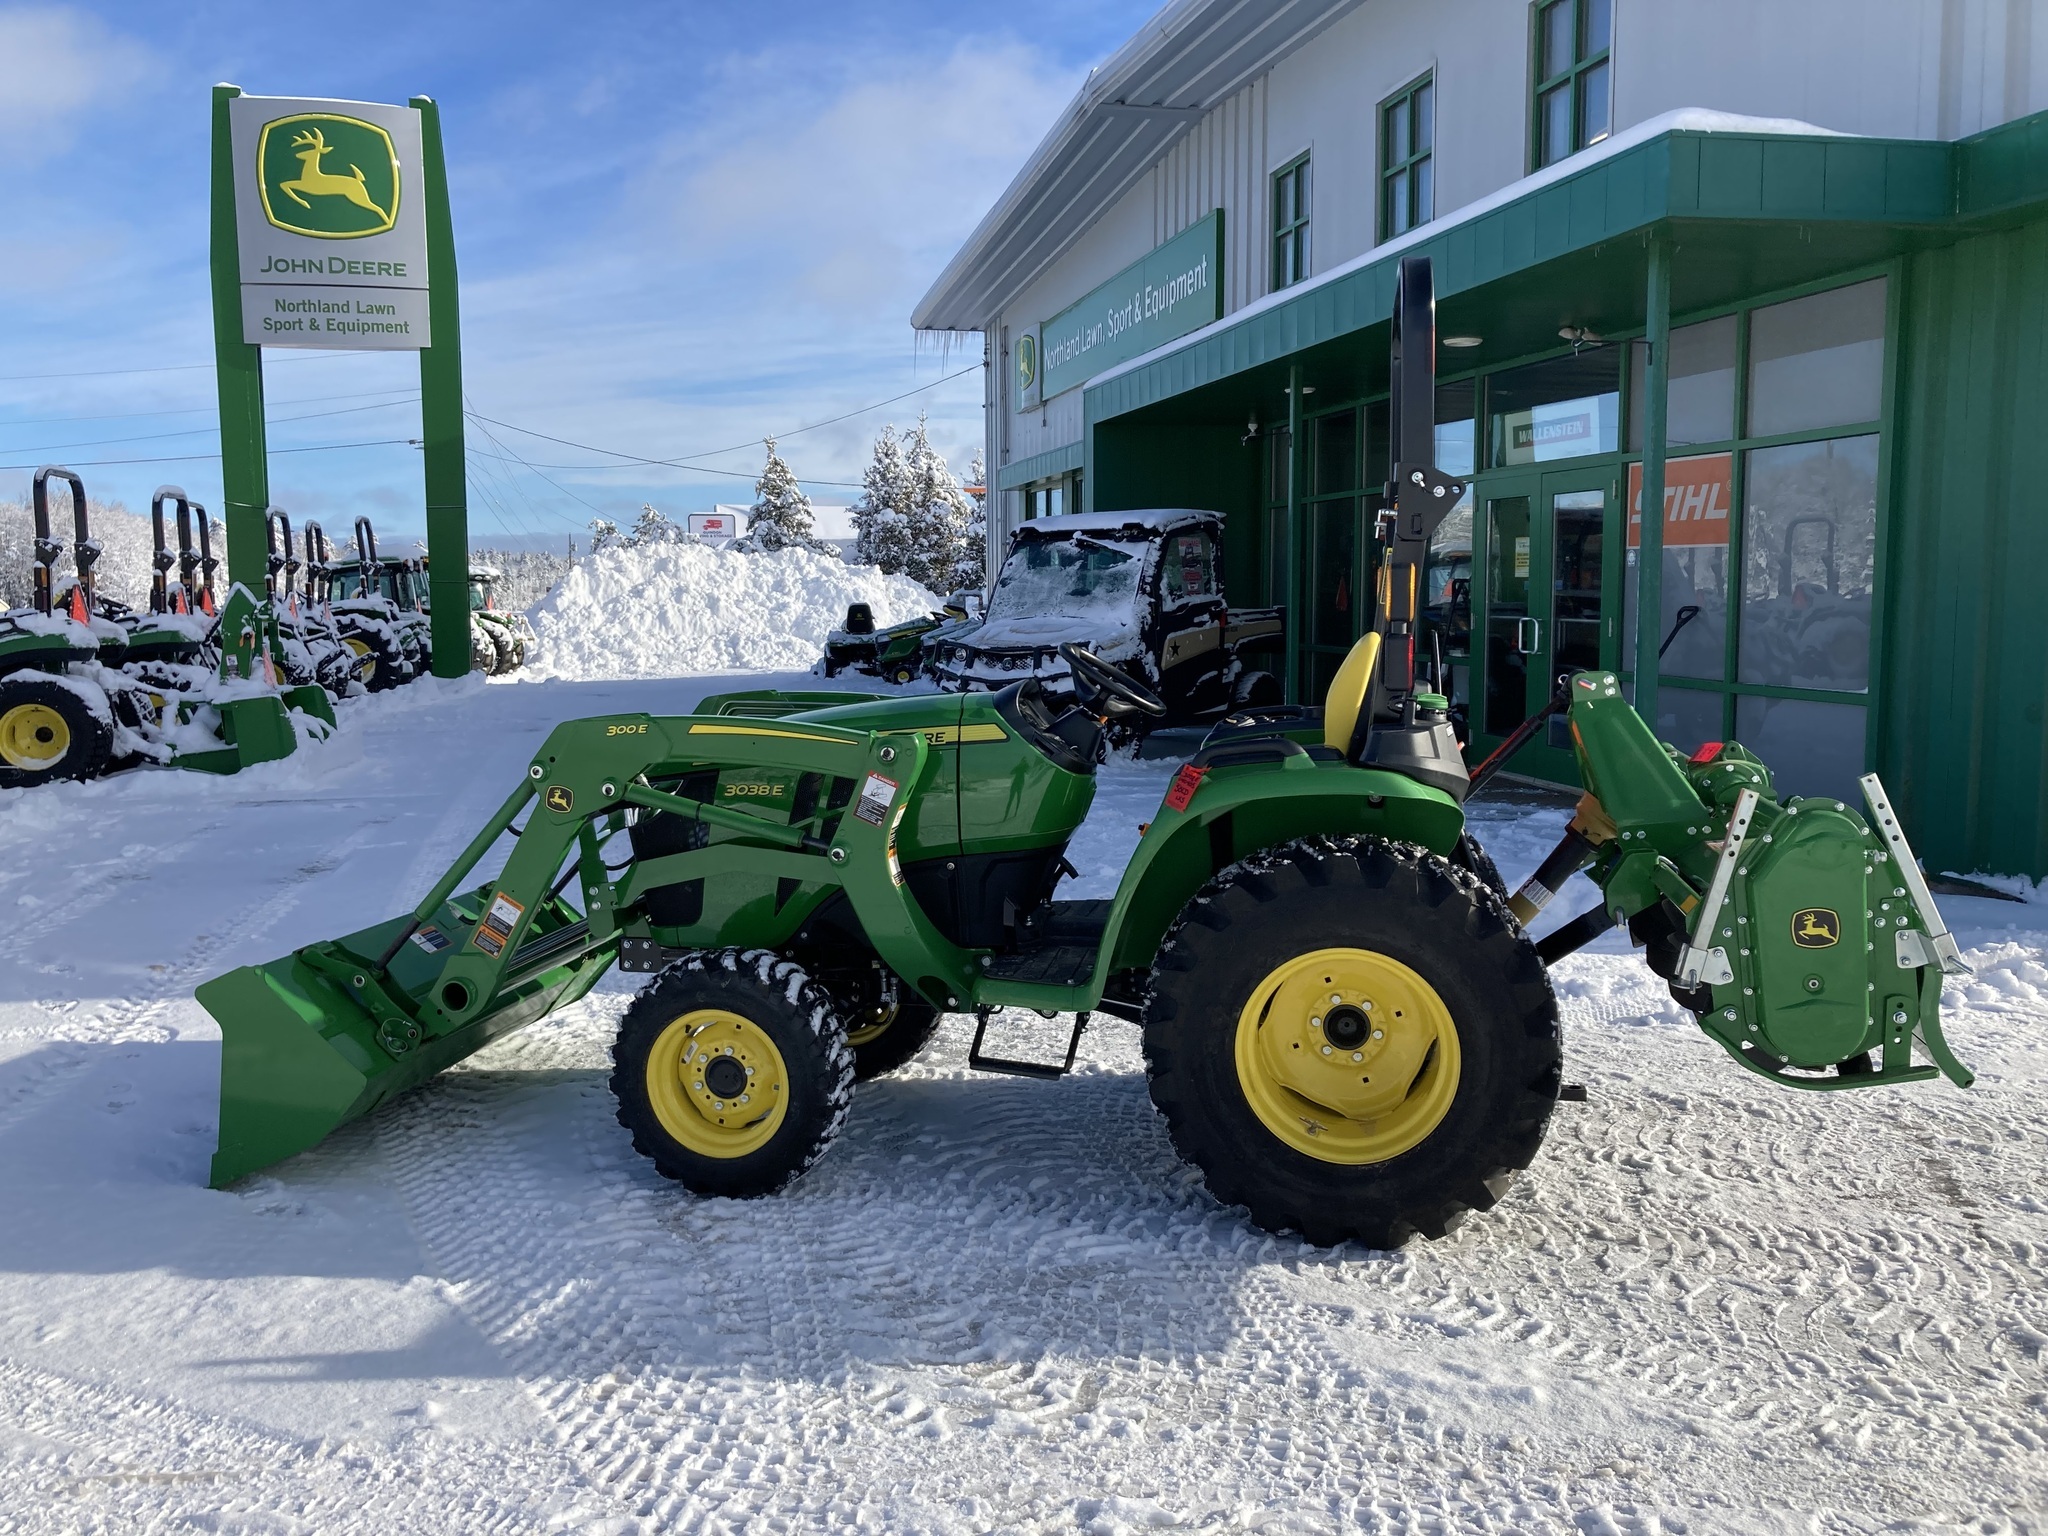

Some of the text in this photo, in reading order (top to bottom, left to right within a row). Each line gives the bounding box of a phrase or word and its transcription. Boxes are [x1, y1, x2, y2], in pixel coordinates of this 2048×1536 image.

[260, 256, 407, 277] JOHN DEERE
[275, 299, 395, 316] Northland Lawn
[1044, 330, 1080, 373] Northland
[1107, 300, 1133, 342] Sport
[1134, 292, 1143, 323] &
[1144, 254, 1208, 320] Equipment
[263, 318, 410, 335] Sport & Equipment
[1519, 420, 1584, 443] WALLENSTEIN
